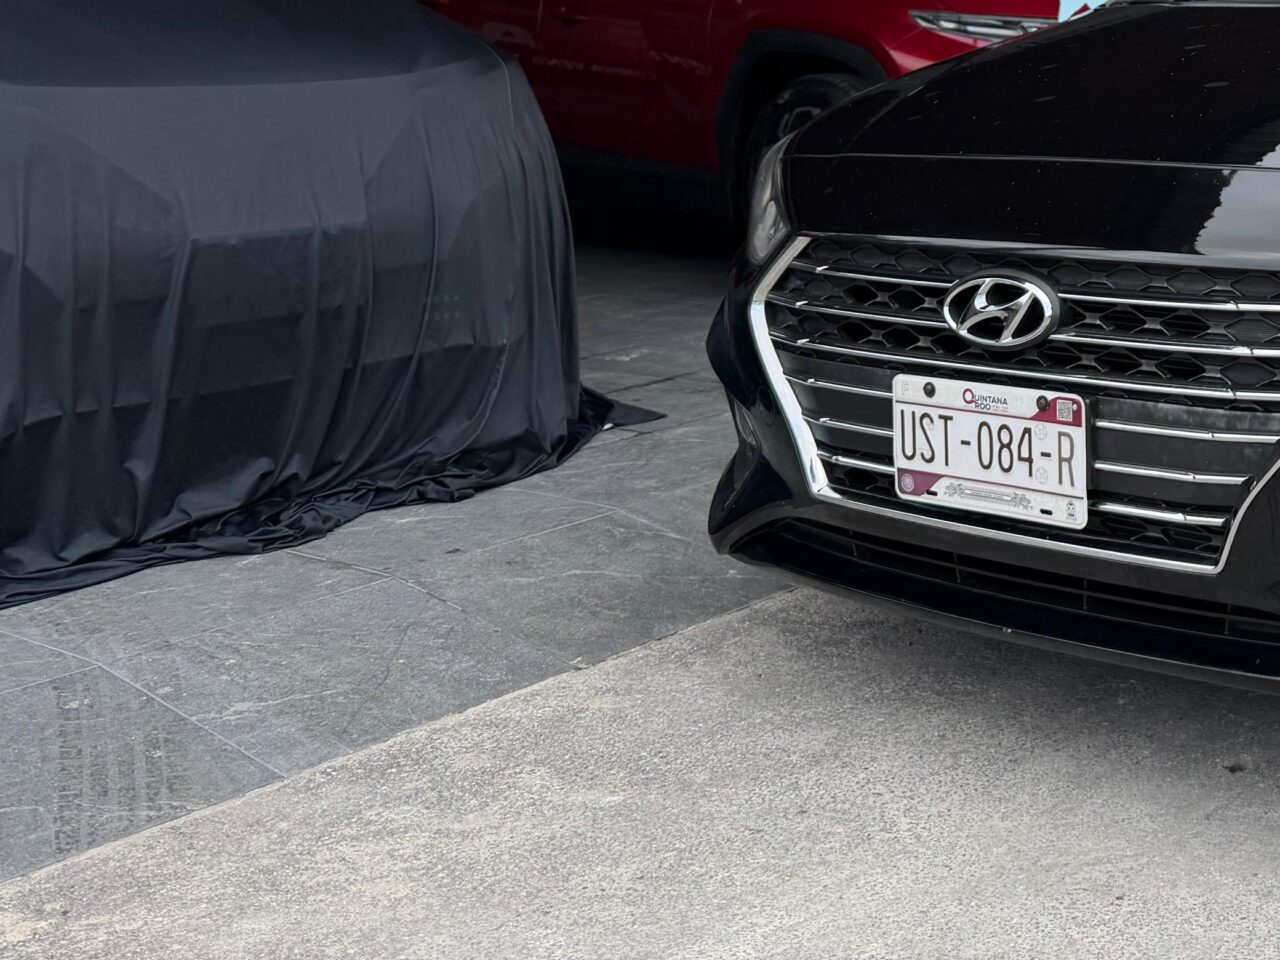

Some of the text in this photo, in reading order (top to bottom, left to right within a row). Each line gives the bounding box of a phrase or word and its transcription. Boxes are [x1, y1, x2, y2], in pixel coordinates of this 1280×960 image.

[962, 388, 1008, 405] QUINTANA
[974, 401, 992, 411] ROO
[900, 408, 1076, 488] UST-084-R
